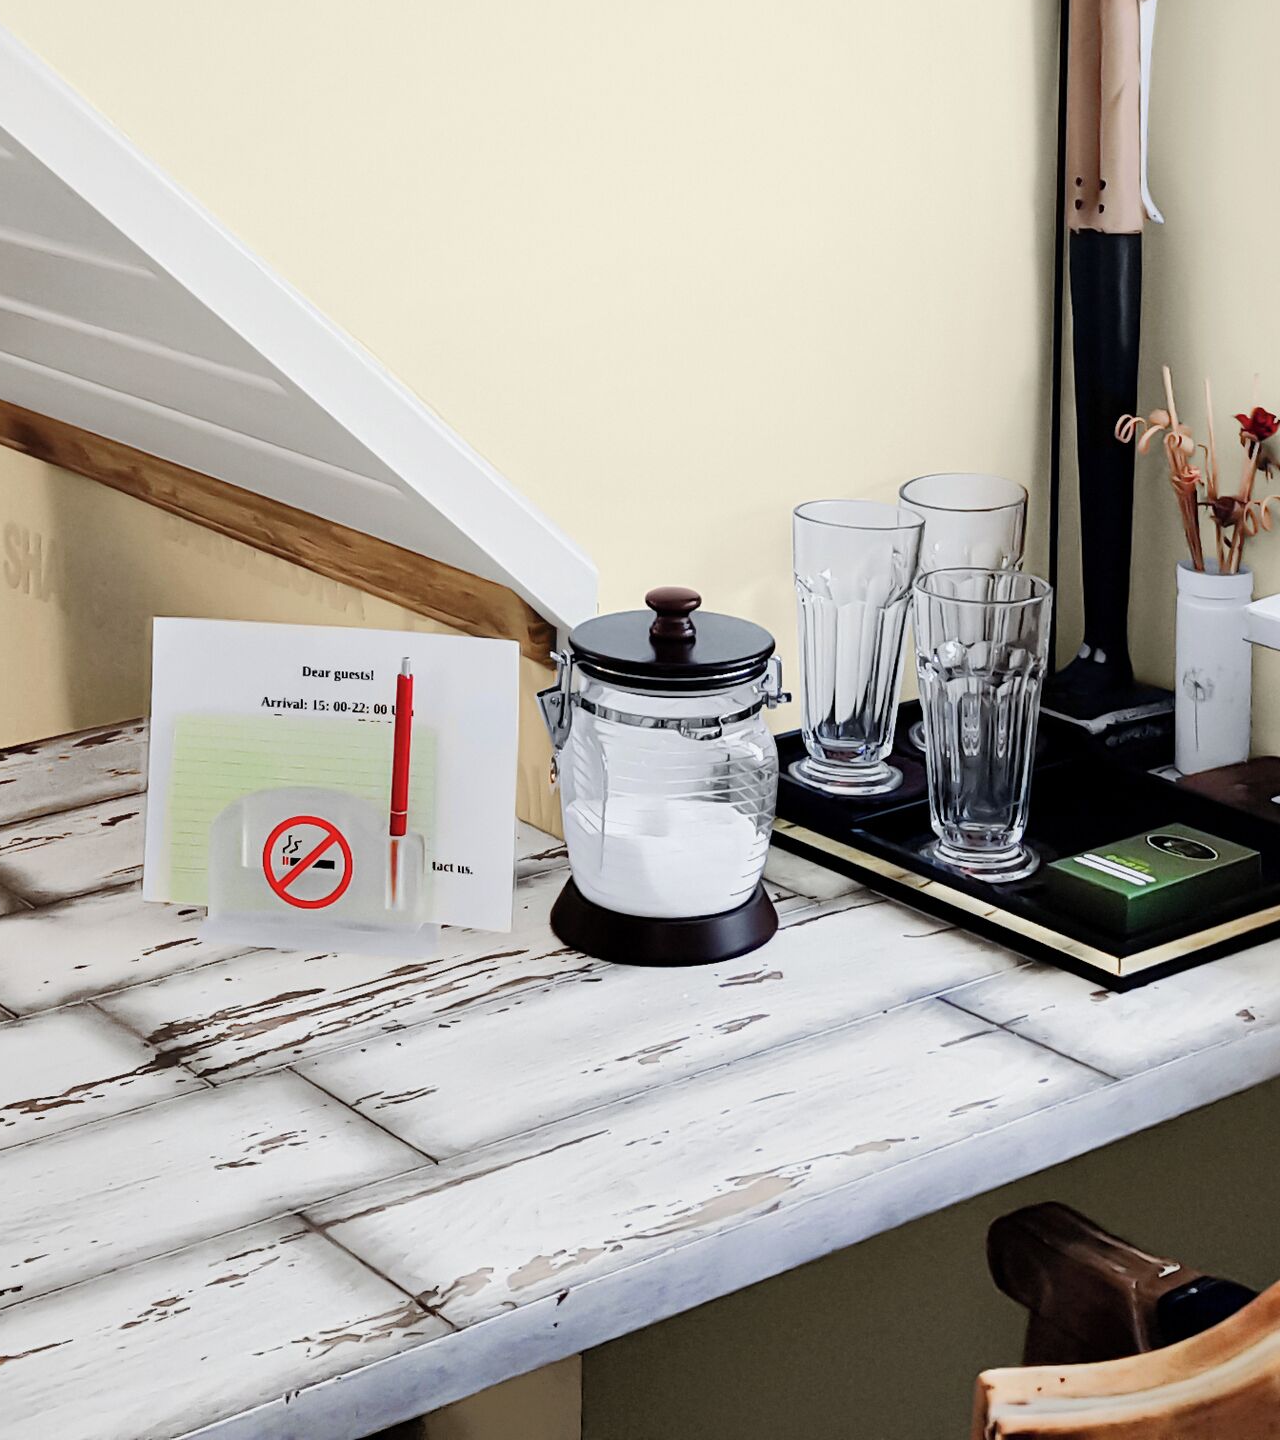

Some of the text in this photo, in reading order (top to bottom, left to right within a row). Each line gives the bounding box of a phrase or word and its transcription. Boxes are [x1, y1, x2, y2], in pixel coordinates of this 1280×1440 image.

[302, 666, 375, 682] Dear guests!
[261, 696, 308, 710] Arrival:
[373, 704, 388, 715] 00
